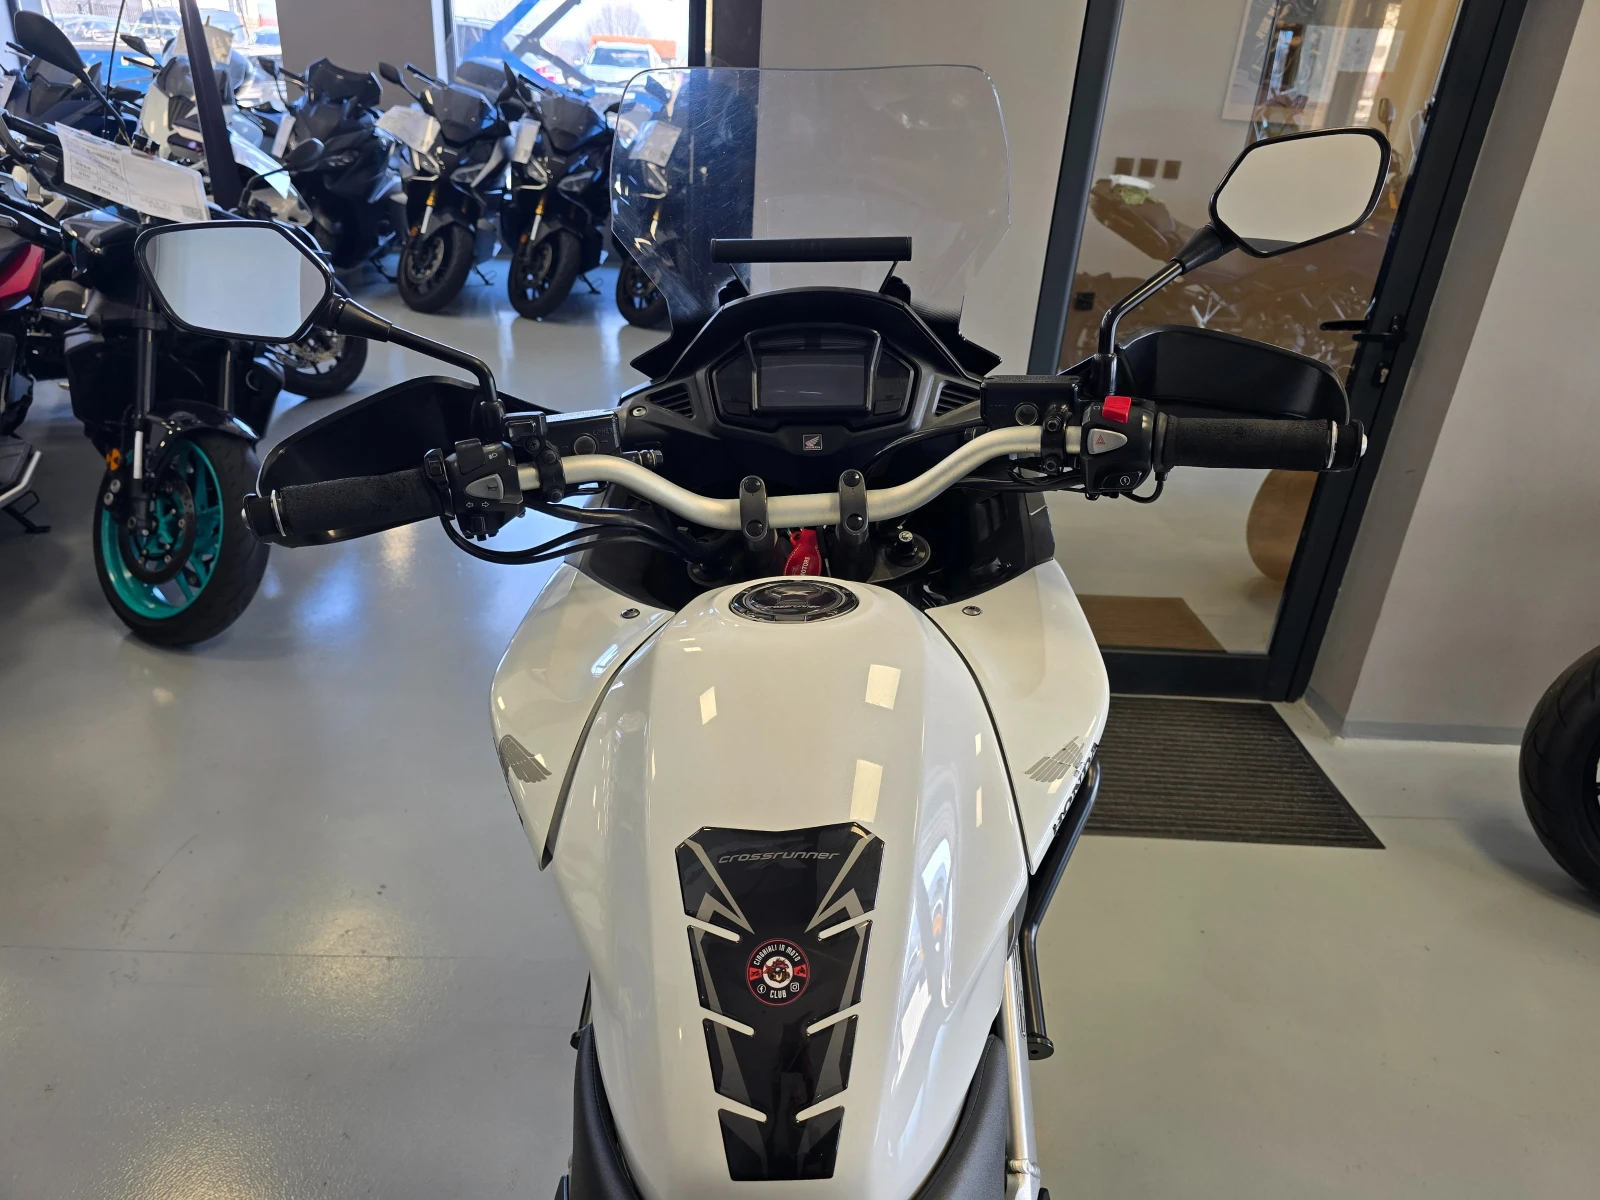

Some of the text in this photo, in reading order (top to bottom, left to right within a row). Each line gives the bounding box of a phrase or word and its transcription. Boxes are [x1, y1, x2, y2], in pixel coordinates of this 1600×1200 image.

[718, 851, 840, 864] crossrunner
[785, 946, 801, 962] MOTO
[770, 989, 787, 999] CLUB
